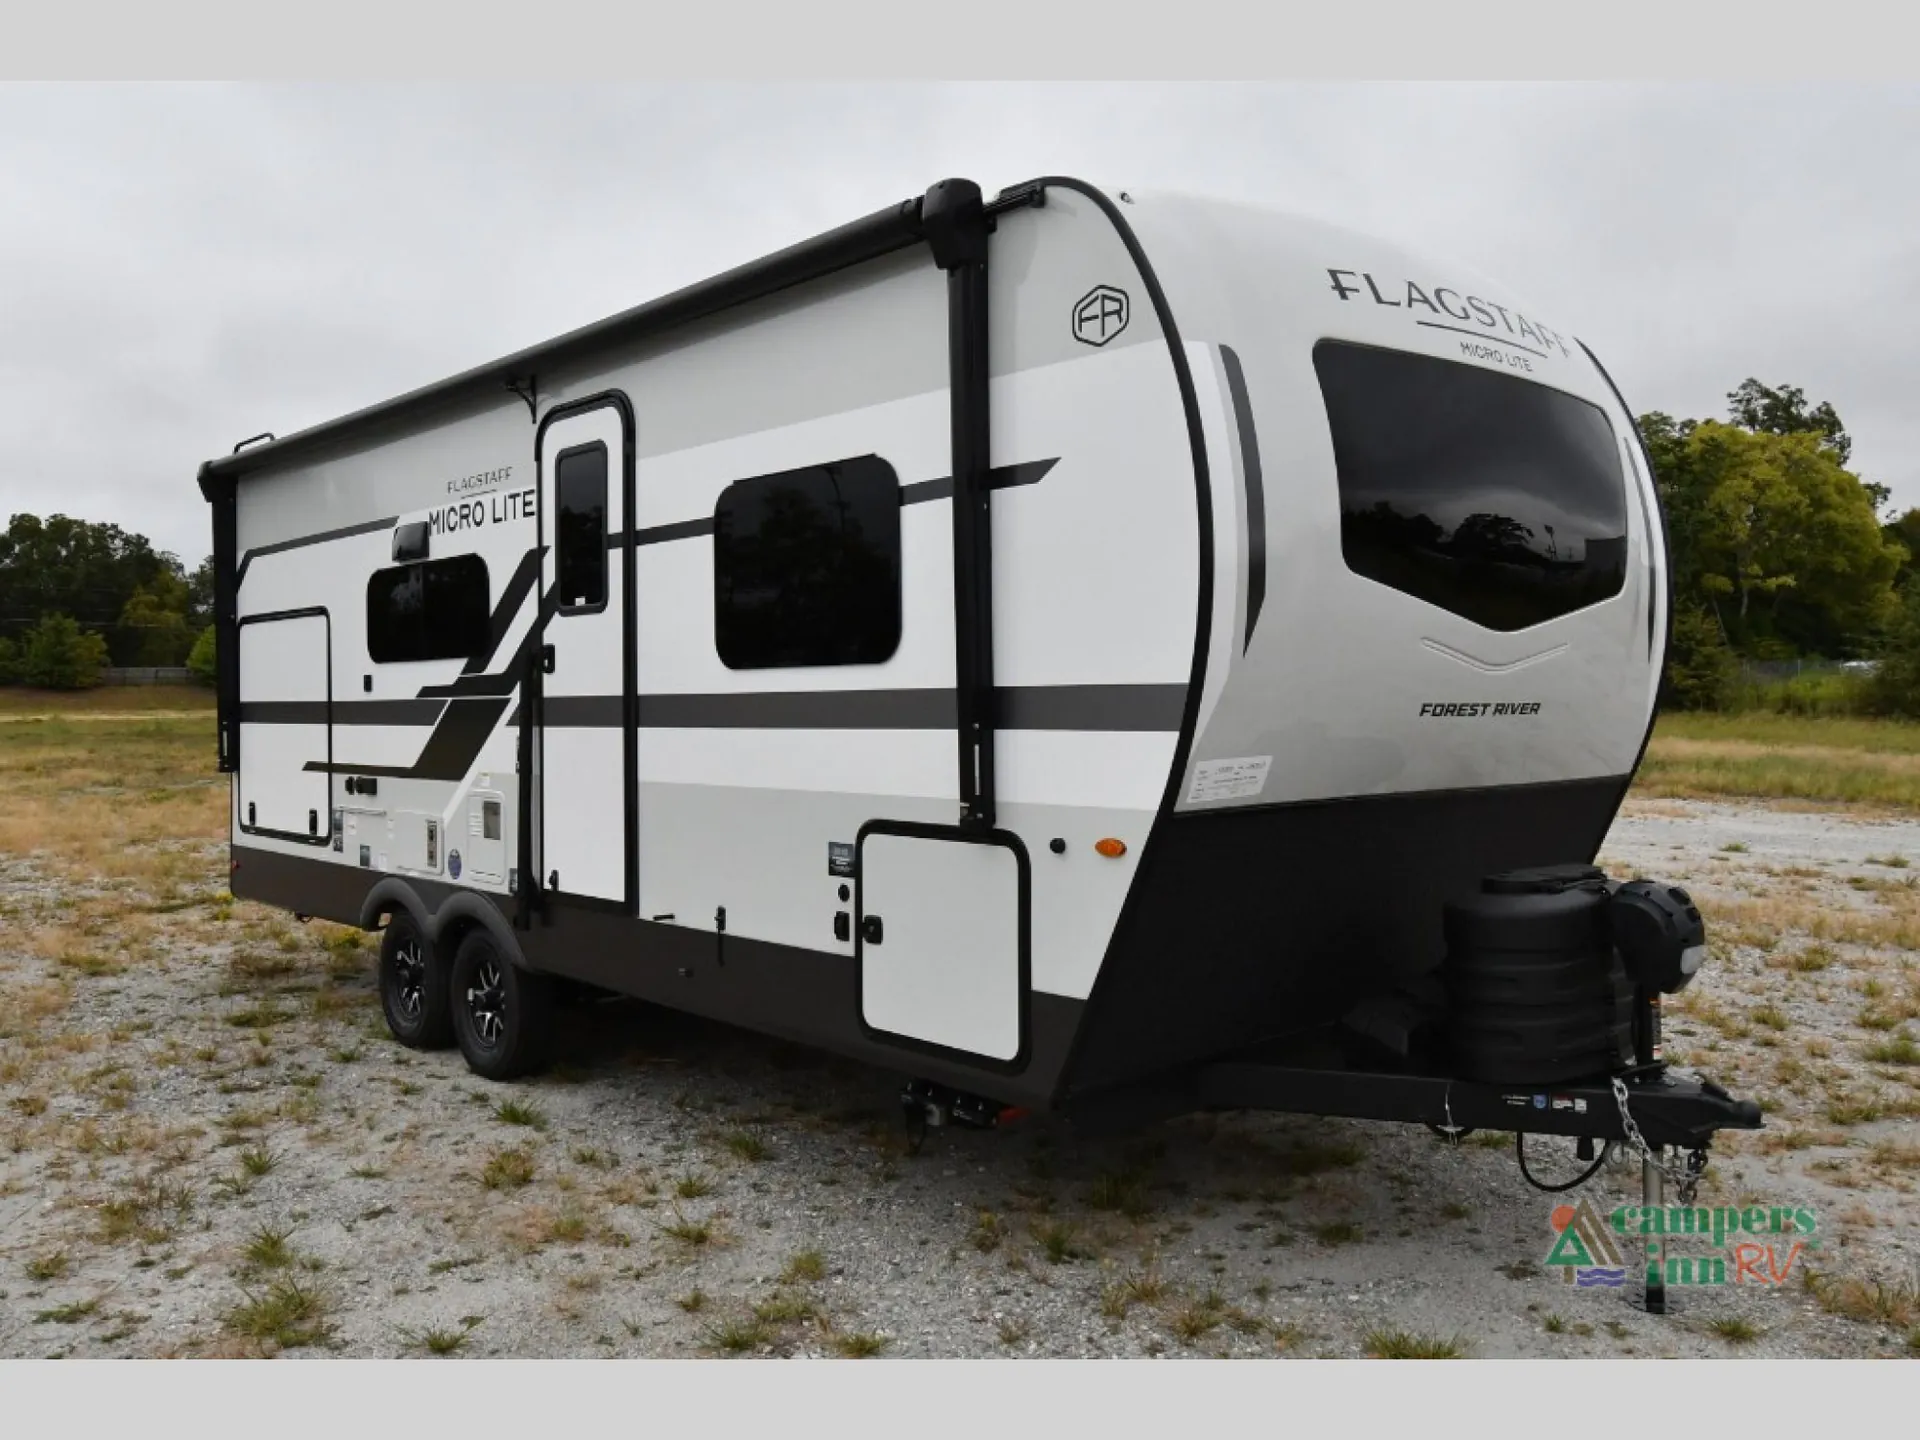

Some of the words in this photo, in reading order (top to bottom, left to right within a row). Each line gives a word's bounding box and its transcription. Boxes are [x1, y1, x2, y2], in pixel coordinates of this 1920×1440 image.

[1327, 268, 1571, 359] FLAGSTAFF
[1459, 340, 1504, 363] MICRO
[1505, 353, 1533, 373] LITE
[446, 465, 514, 494] FLAGSTAFF
[427, 500, 485, 537] MICRO
[492, 489, 537, 524] LITE
[1419, 702, 1491, 717] FOREST
[1492, 702, 1542, 716] RIVER
